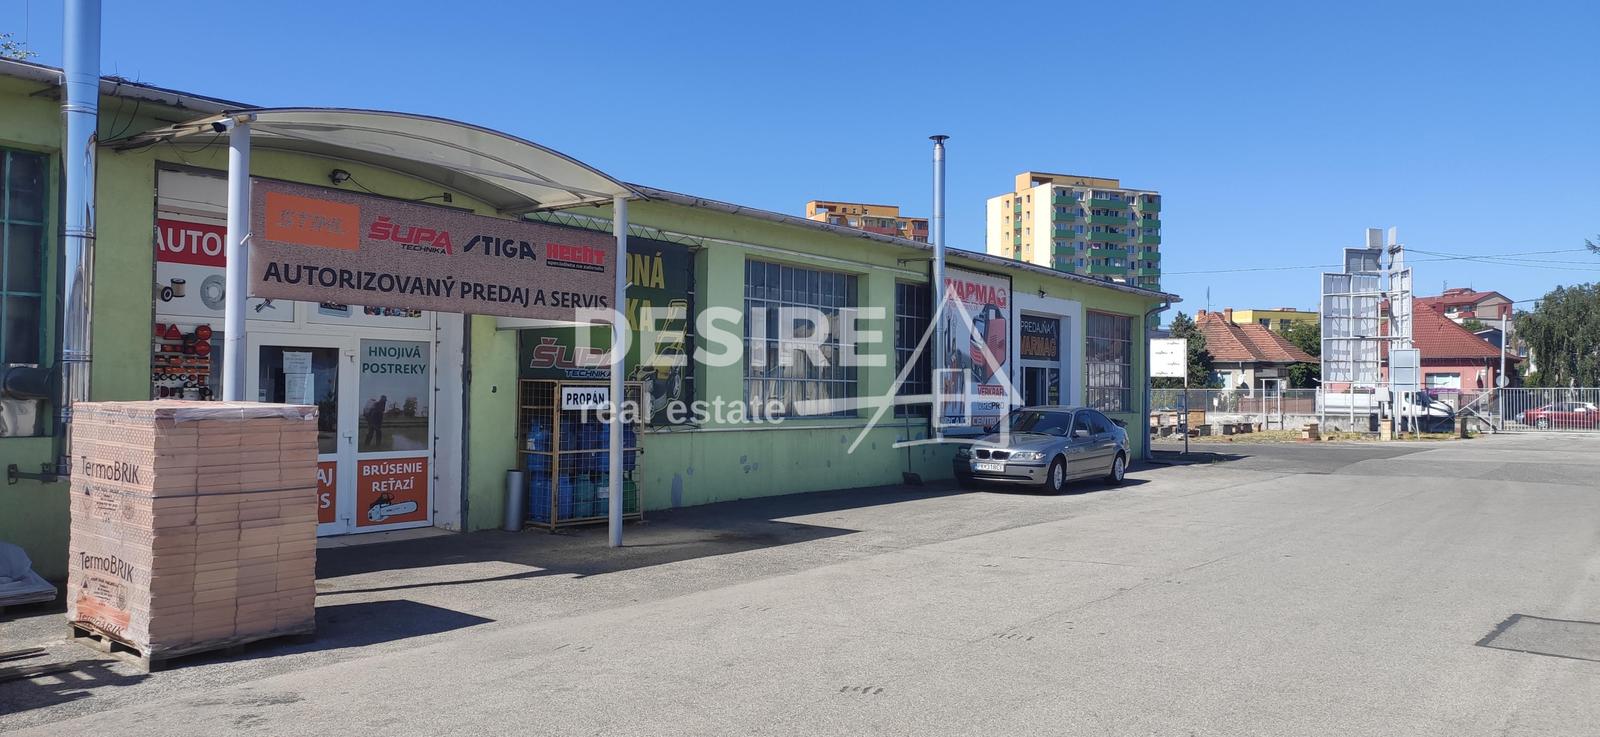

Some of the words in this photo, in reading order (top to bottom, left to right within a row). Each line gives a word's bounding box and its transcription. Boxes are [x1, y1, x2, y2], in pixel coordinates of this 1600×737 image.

[156, 225, 228, 257] AUTO
[368, 215, 453, 256] ŠUPA
[401, 243, 447, 255] TECHNIKA
[463, 235, 537, 261] STIGA
[263, 262, 456, 298] AUTORIZOVANÝ
[460, 281, 530, 308] PREDAJ
[534, 289, 546, 306] A
[550, 290, 608, 309] SERVIS
[368, 345, 421, 359] HNOJIVÁ
[362, 363, 426, 375] POSTREKY
[566, 391, 605, 405] PROPÁN
[81, 455, 140, 484] TermoBRIK
[362, 462, 423, 476] BRÚSENIE
[372, 476, 416, 492] REŤAZÍ
[80, 551, 135, 583] TermoBRIK
